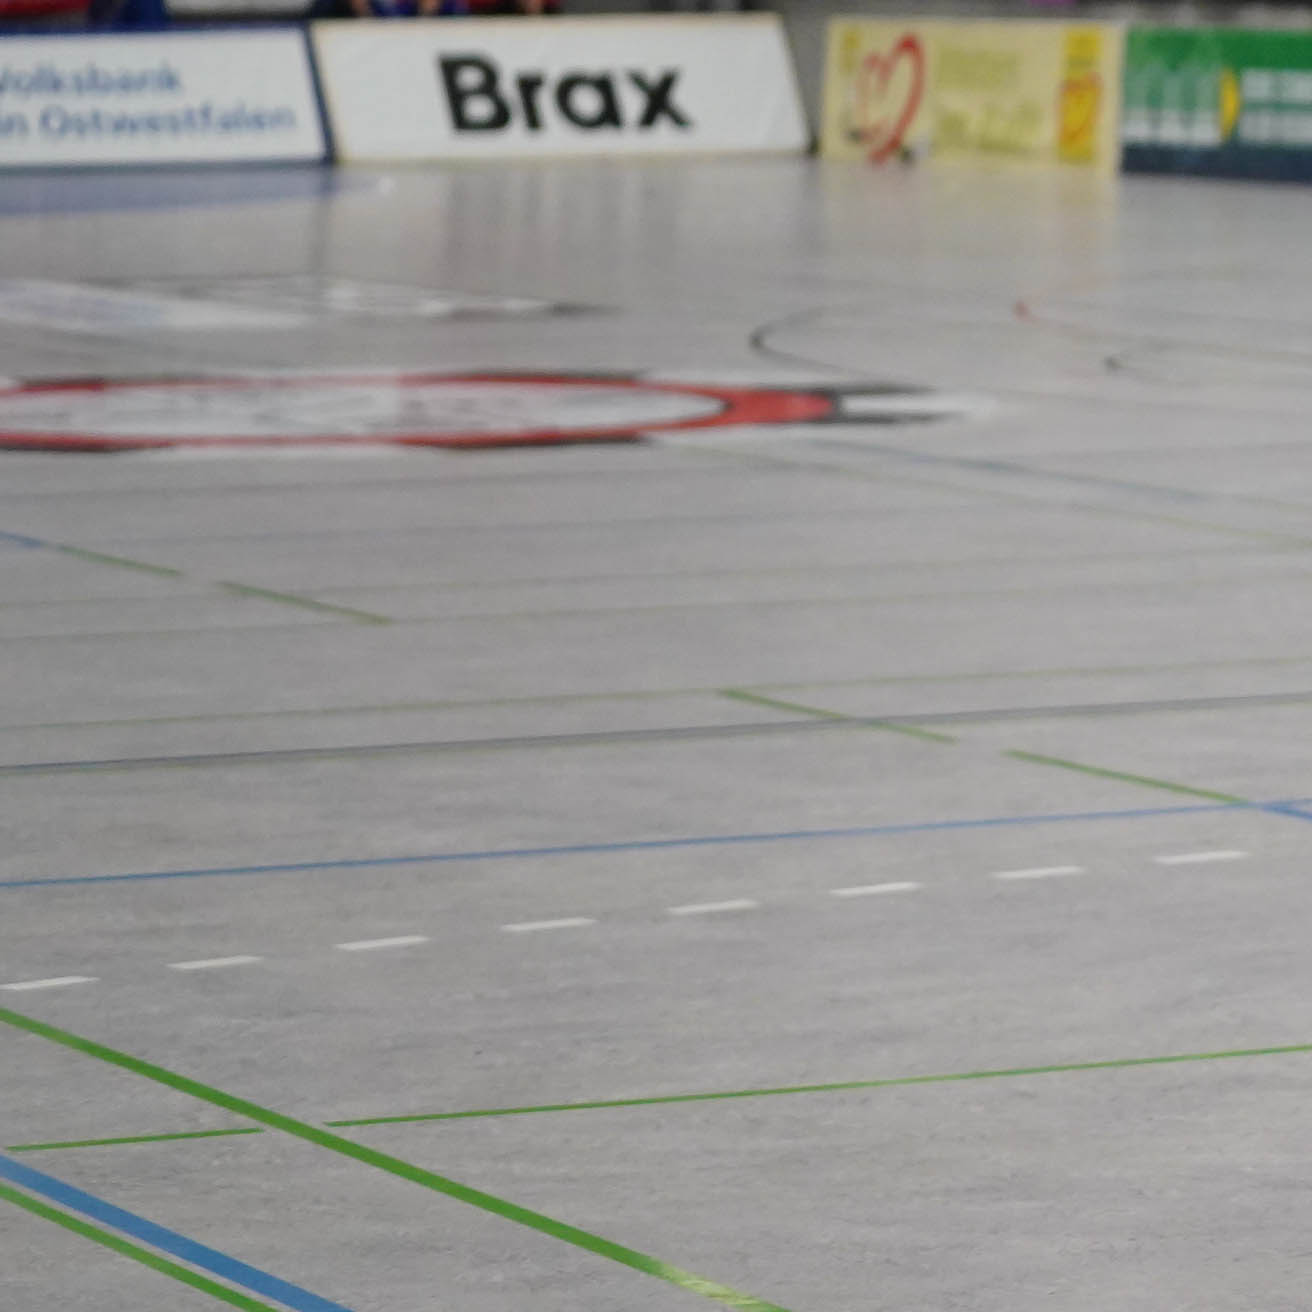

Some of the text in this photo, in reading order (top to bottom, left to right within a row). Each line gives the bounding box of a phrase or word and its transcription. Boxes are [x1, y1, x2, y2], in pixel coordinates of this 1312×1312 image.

[0, 63, 182, 94] olksbank
[438, 54, 690, 134] Brax
[40, 100, 296, 140] Ostwestfalen
